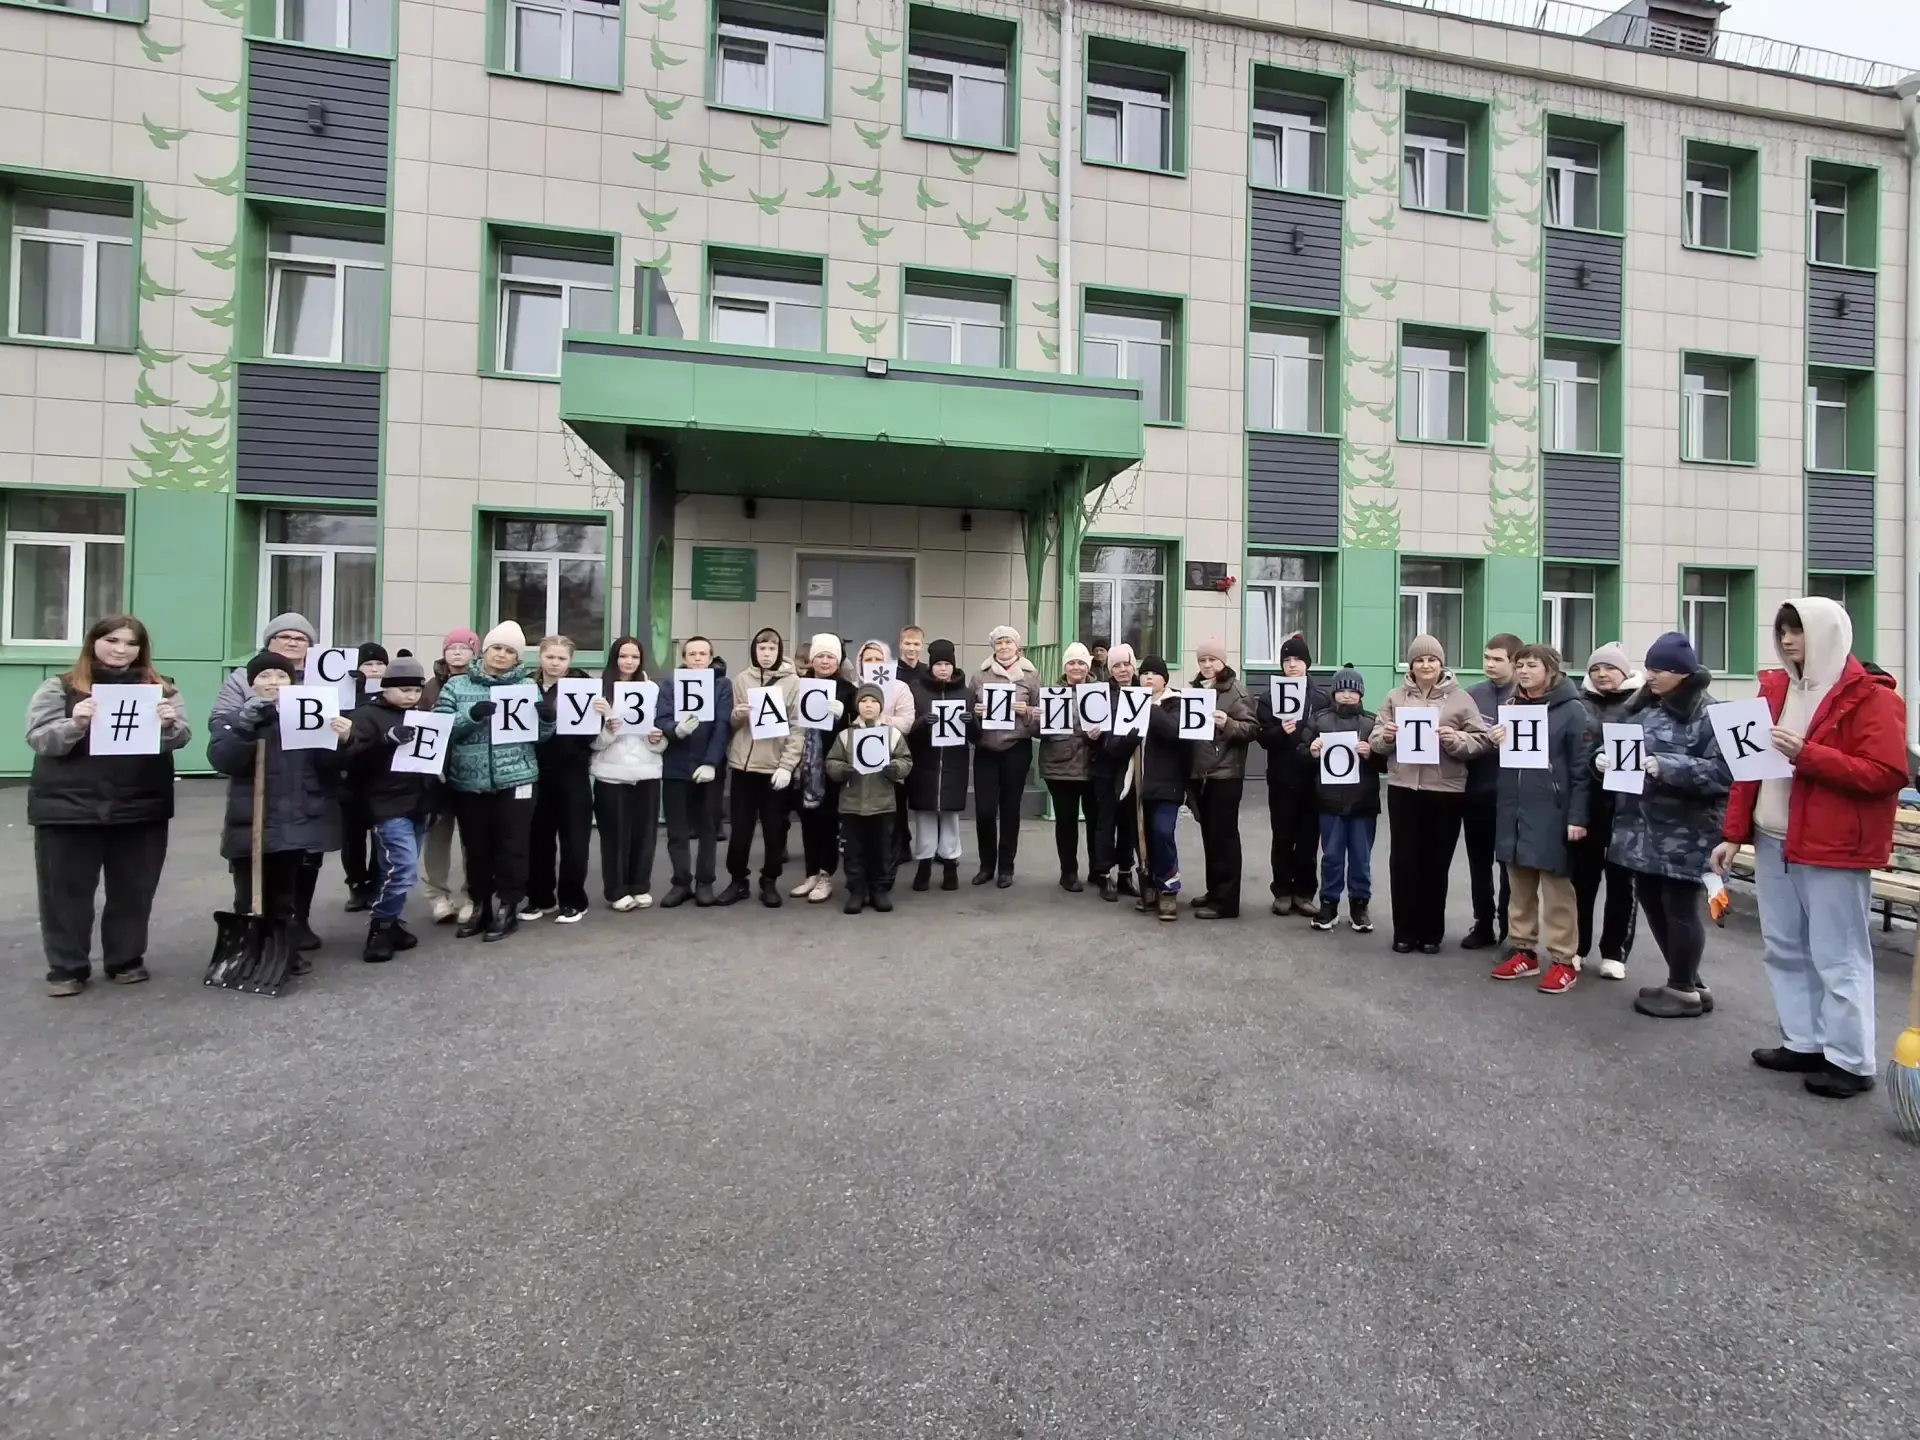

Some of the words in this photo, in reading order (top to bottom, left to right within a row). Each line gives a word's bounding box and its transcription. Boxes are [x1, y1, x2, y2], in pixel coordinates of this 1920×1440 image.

[317, 649, 346, 682] С
[564, 693, 596, 726] У
[623, 692, 645, 725] З
[679, 680, 704, 712] Б
[755, 693, 789, 727] А
[799, 690, 829, 722] С
[985, 690, 1015, 721] И
[1044, 688, 1073, 729] Й
[1079, 691, 1108, 724] С
[1122, 690, 1152, 723] У
[1275, 682, 1301, 715] Б
[110, 699, 140, 742] #
[296, 699, 324, 731] В
[498, 698, 530, 731] К
[936, 705, 964, 737] К
[1181, 698, 1206, 730] Б
[411, 726, 439, 760] Е
[857, 735, 885, 768] С
[1405, 720, 1432, 752] Т
[1509, 720, 1542, 752] Н
[1730, 721, 1766, 759] К
[1324, 745, 1354, 777] О
[1612, 739, 1644, 771] И
